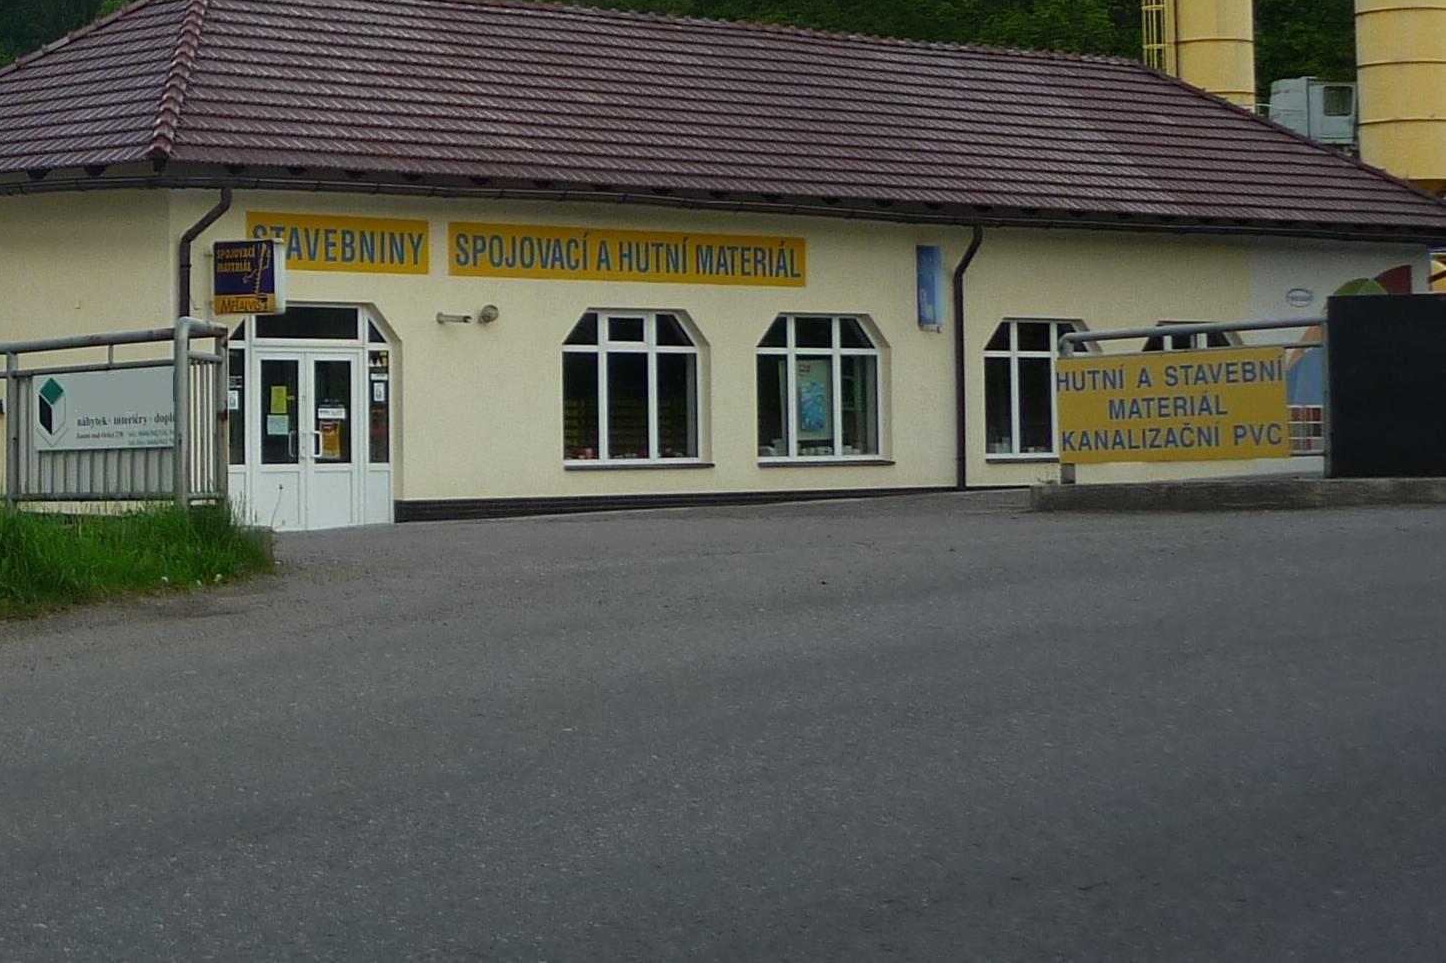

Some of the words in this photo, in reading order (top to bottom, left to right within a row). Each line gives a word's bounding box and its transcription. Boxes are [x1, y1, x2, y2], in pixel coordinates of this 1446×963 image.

[456, 232, 589, 271] SPOJOVACÍ
[596, 239, 611, 271] A
[618, 237, 688, 274] HUTNÍ
[696, 240, 802, 279] MATERIÁL
[1056, 365, 1124, 392] HUTNÍ
[1138, 368, 1152, 388] A
[1165, 355, 1283, 387] STAVEBNÍ
[1109, 391, 1228, 420] MATERIÁL
[1062, 421, 1219, 451] KANALIZAČNÍ
[1234, 423, 1282, 446] PVC
